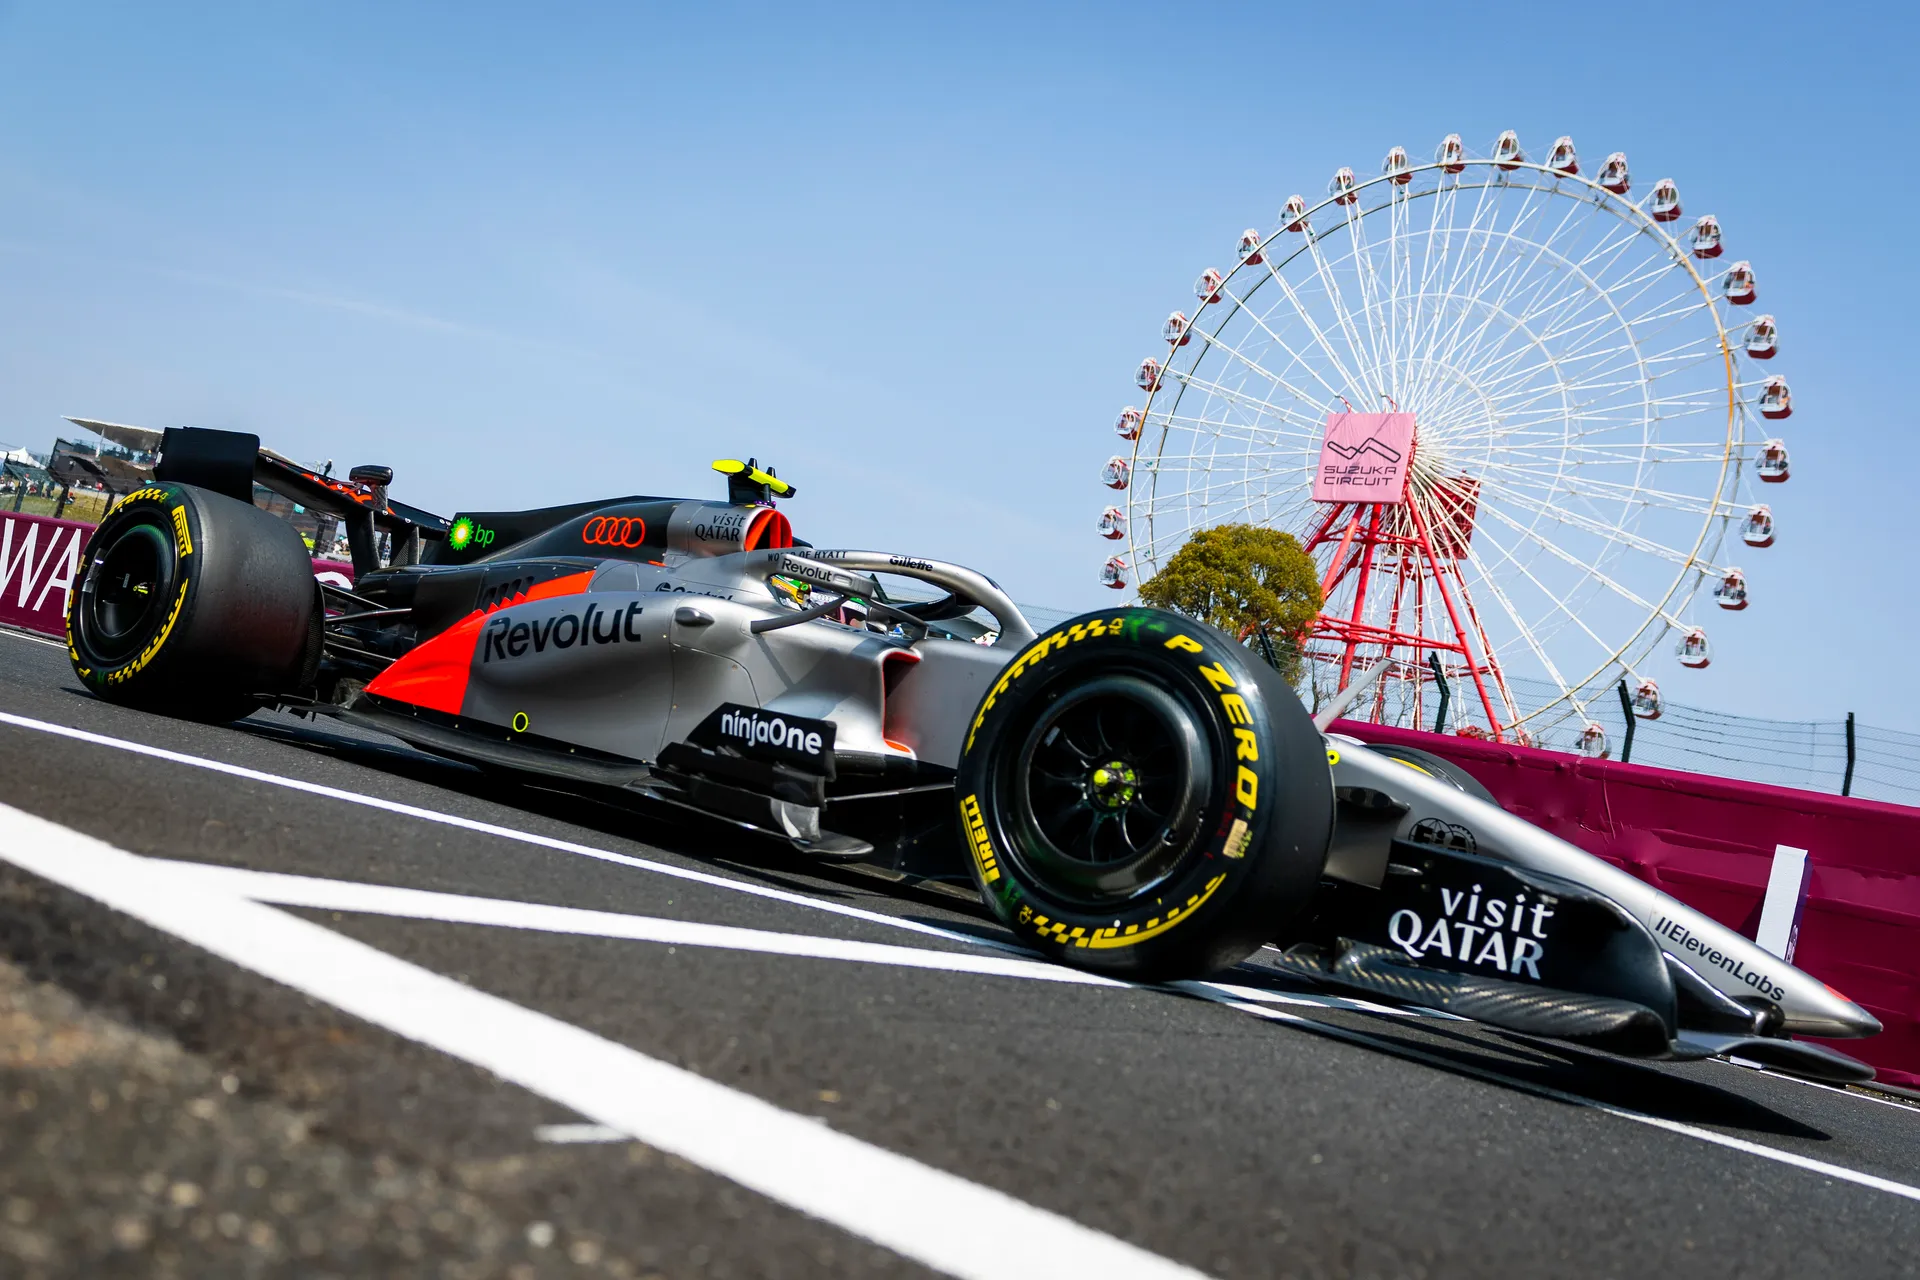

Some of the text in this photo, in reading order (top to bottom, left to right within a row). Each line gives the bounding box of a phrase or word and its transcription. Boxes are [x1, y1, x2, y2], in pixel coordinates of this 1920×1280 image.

[1323, 476, 1394, 486] CIRCUIT
[1324, 465, 1397, 475] SUZUKA
[171, 504, 193, 559] PIRELLI
[474, 523, 495, 547] bp
[695, 523, 740, 542] QATAR
[713, 513, 747, 527] visit
[0, 517, 82, 618] WA
[781, 557, 832, 582] Revolut
[814, 550, 848, 559] HYATT
[889, 555, 933, 571] Gillette
[483, 601, 644, 664] Revolut
[721, 709, 823, 755] ninjaOne
[1164, 634, 1204, 654] P
[1198, 661, 1259, 812] ZERO
[960, 794, 1001, 886] PIRELLI
[1440, 883, 1555, 939] visit
[1388, 909, 1545, 980] QATAR
